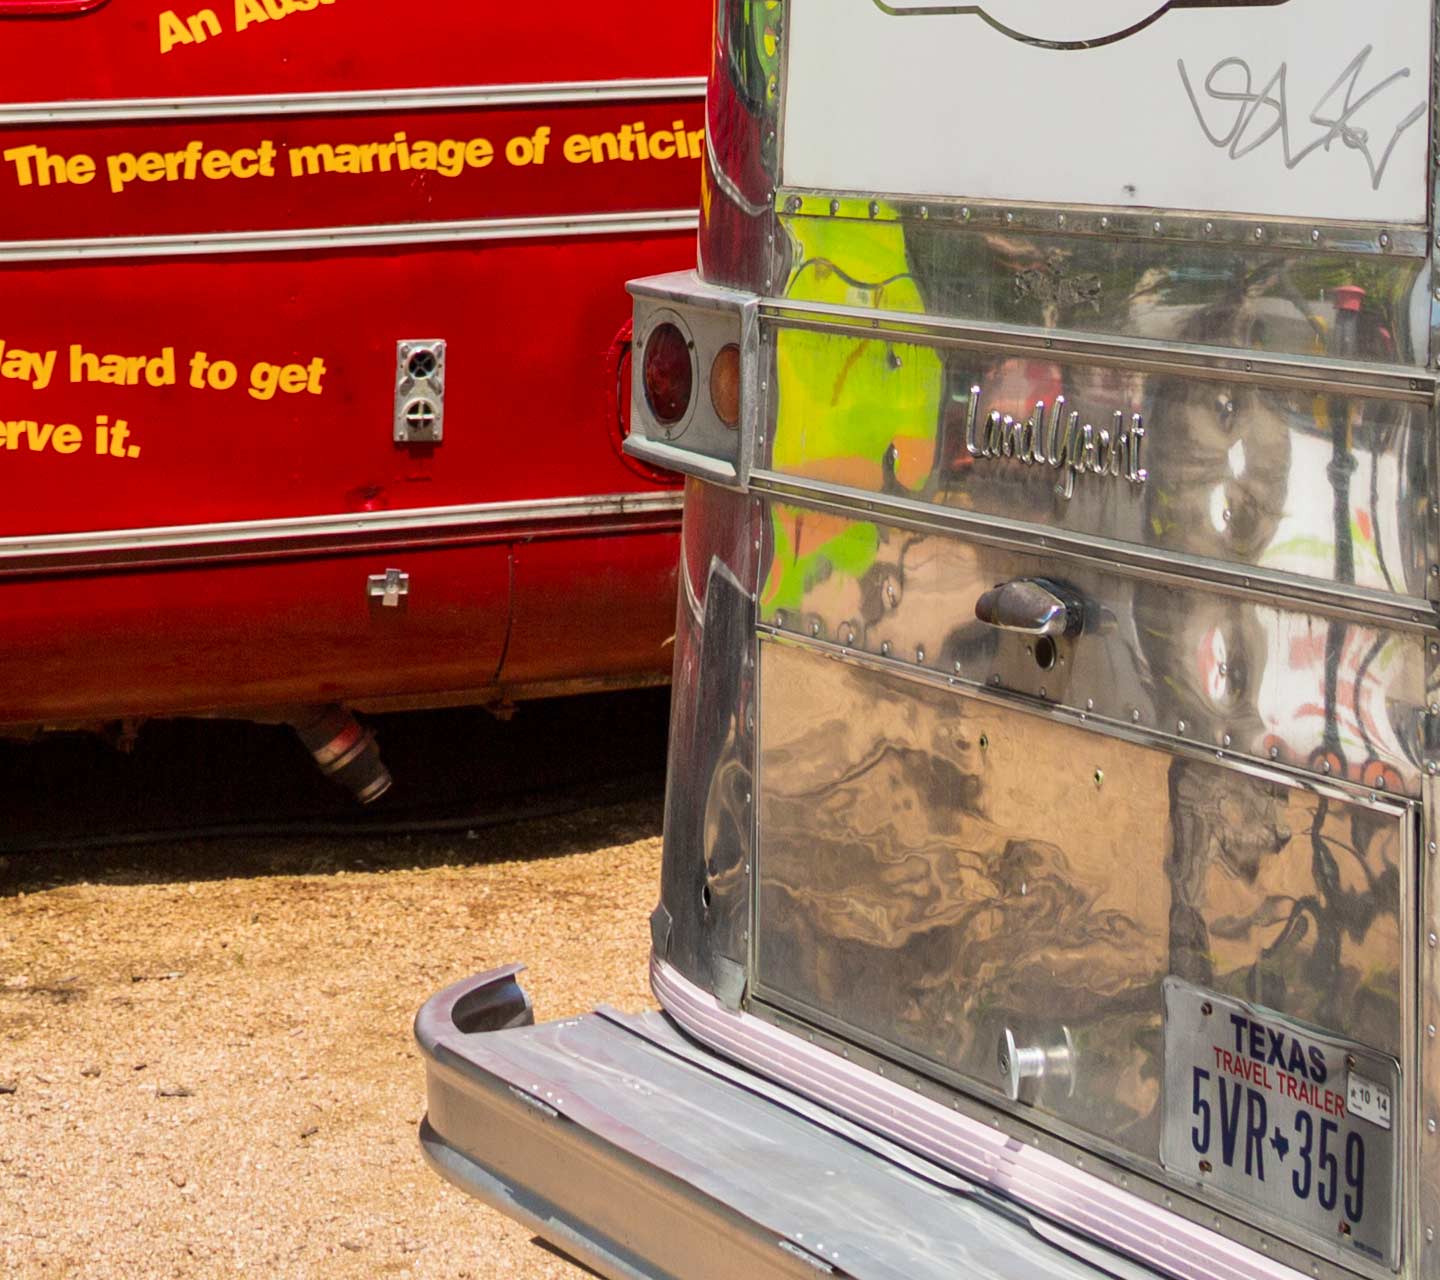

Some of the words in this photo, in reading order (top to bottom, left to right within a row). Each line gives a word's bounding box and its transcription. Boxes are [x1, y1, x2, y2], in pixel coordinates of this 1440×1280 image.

[157, 8, 223, 54] An
[3, 144, 97, 187] The
[107, 139, 278, 193] perfect
[289, 131, 494, 177] marriage
[504, 126, 552, 168] of
[69, 344, 176, 388] hard
[188, 351, 238, 390] to
[247, 356, 327, 401] get
[95, 415, 142, 459] it.
[1230, 1013, 1328, 1084] TEXAS
[1212, 1045, 1273, 1090] TRAVEL
[1276, 1070, 1346, 1119] TRAILER
[1376, 1095, 1388, 1113] 14
